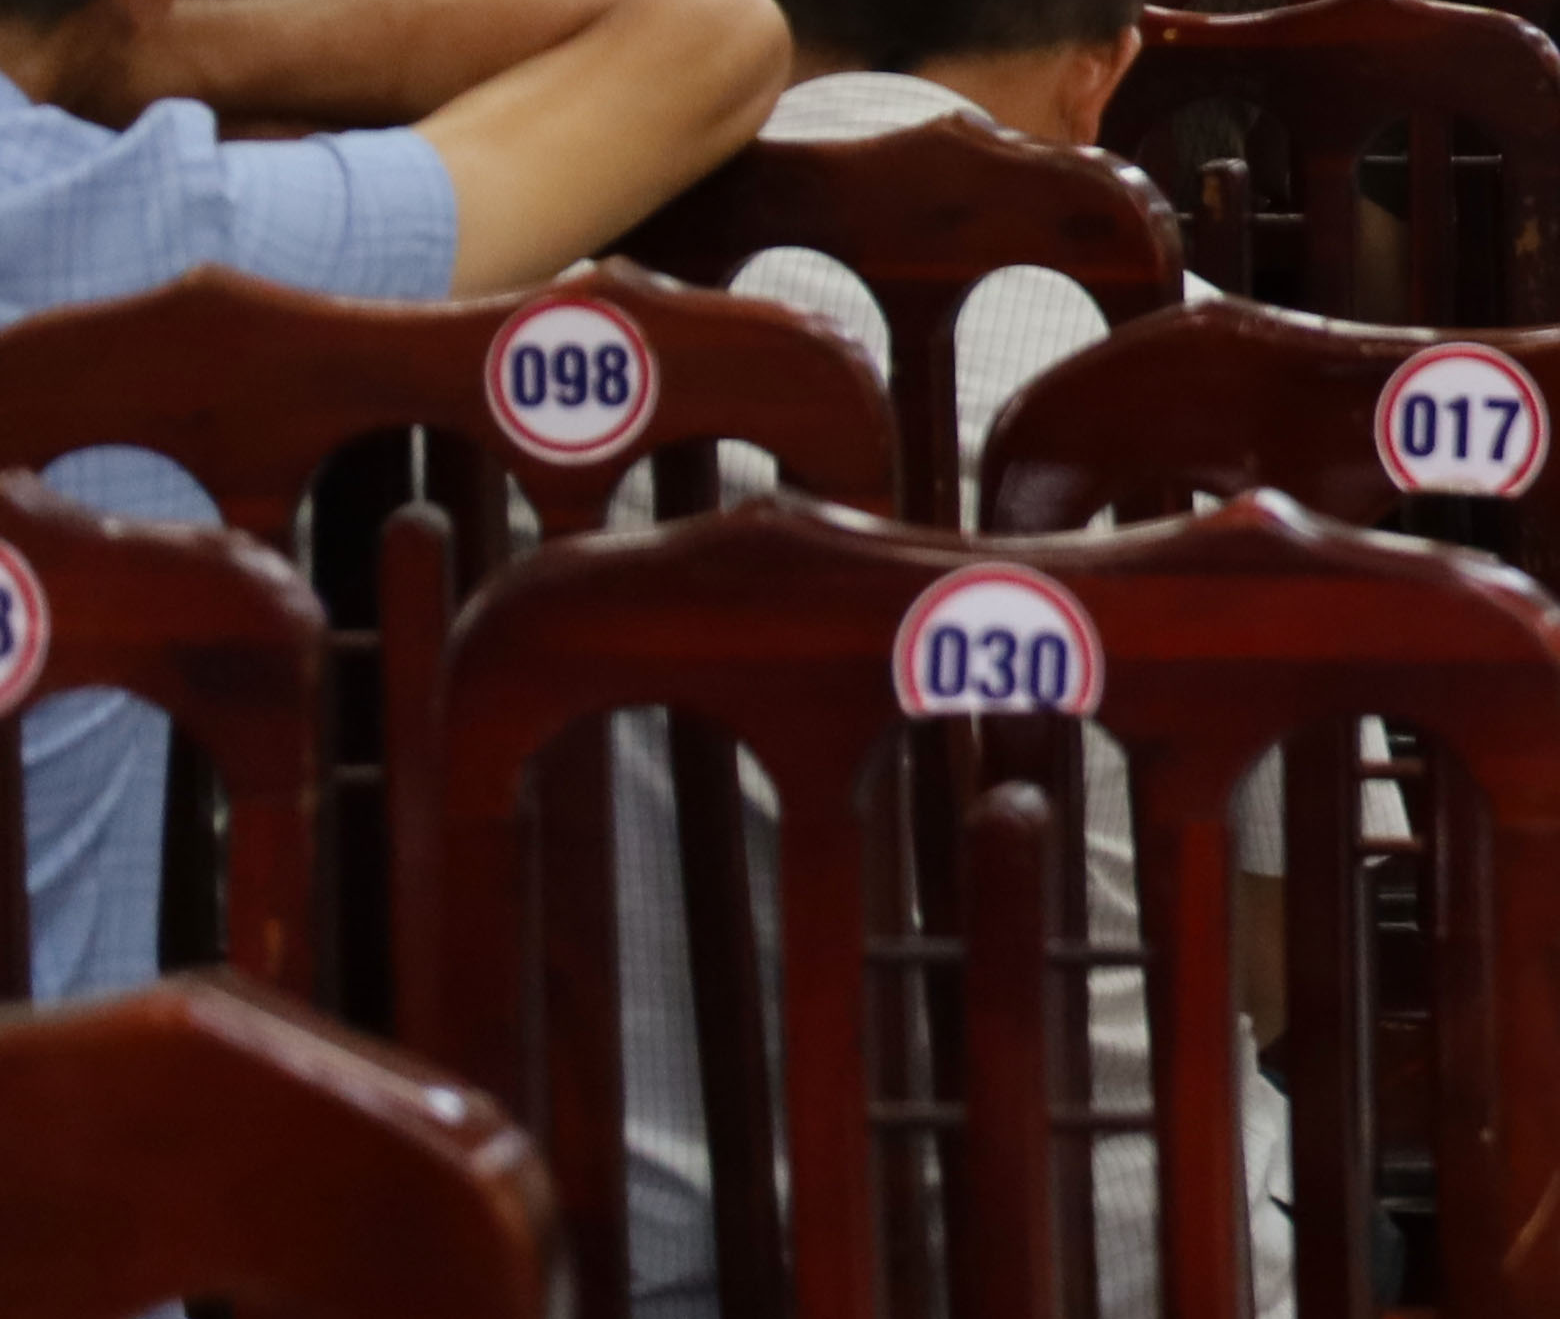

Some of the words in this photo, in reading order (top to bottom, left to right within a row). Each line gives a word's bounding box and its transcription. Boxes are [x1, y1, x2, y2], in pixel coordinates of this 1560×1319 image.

[515, 347, 628, 409] 098
[1403, 395, 1520, 462] 017
[927, 627, 1068, 700] 030
